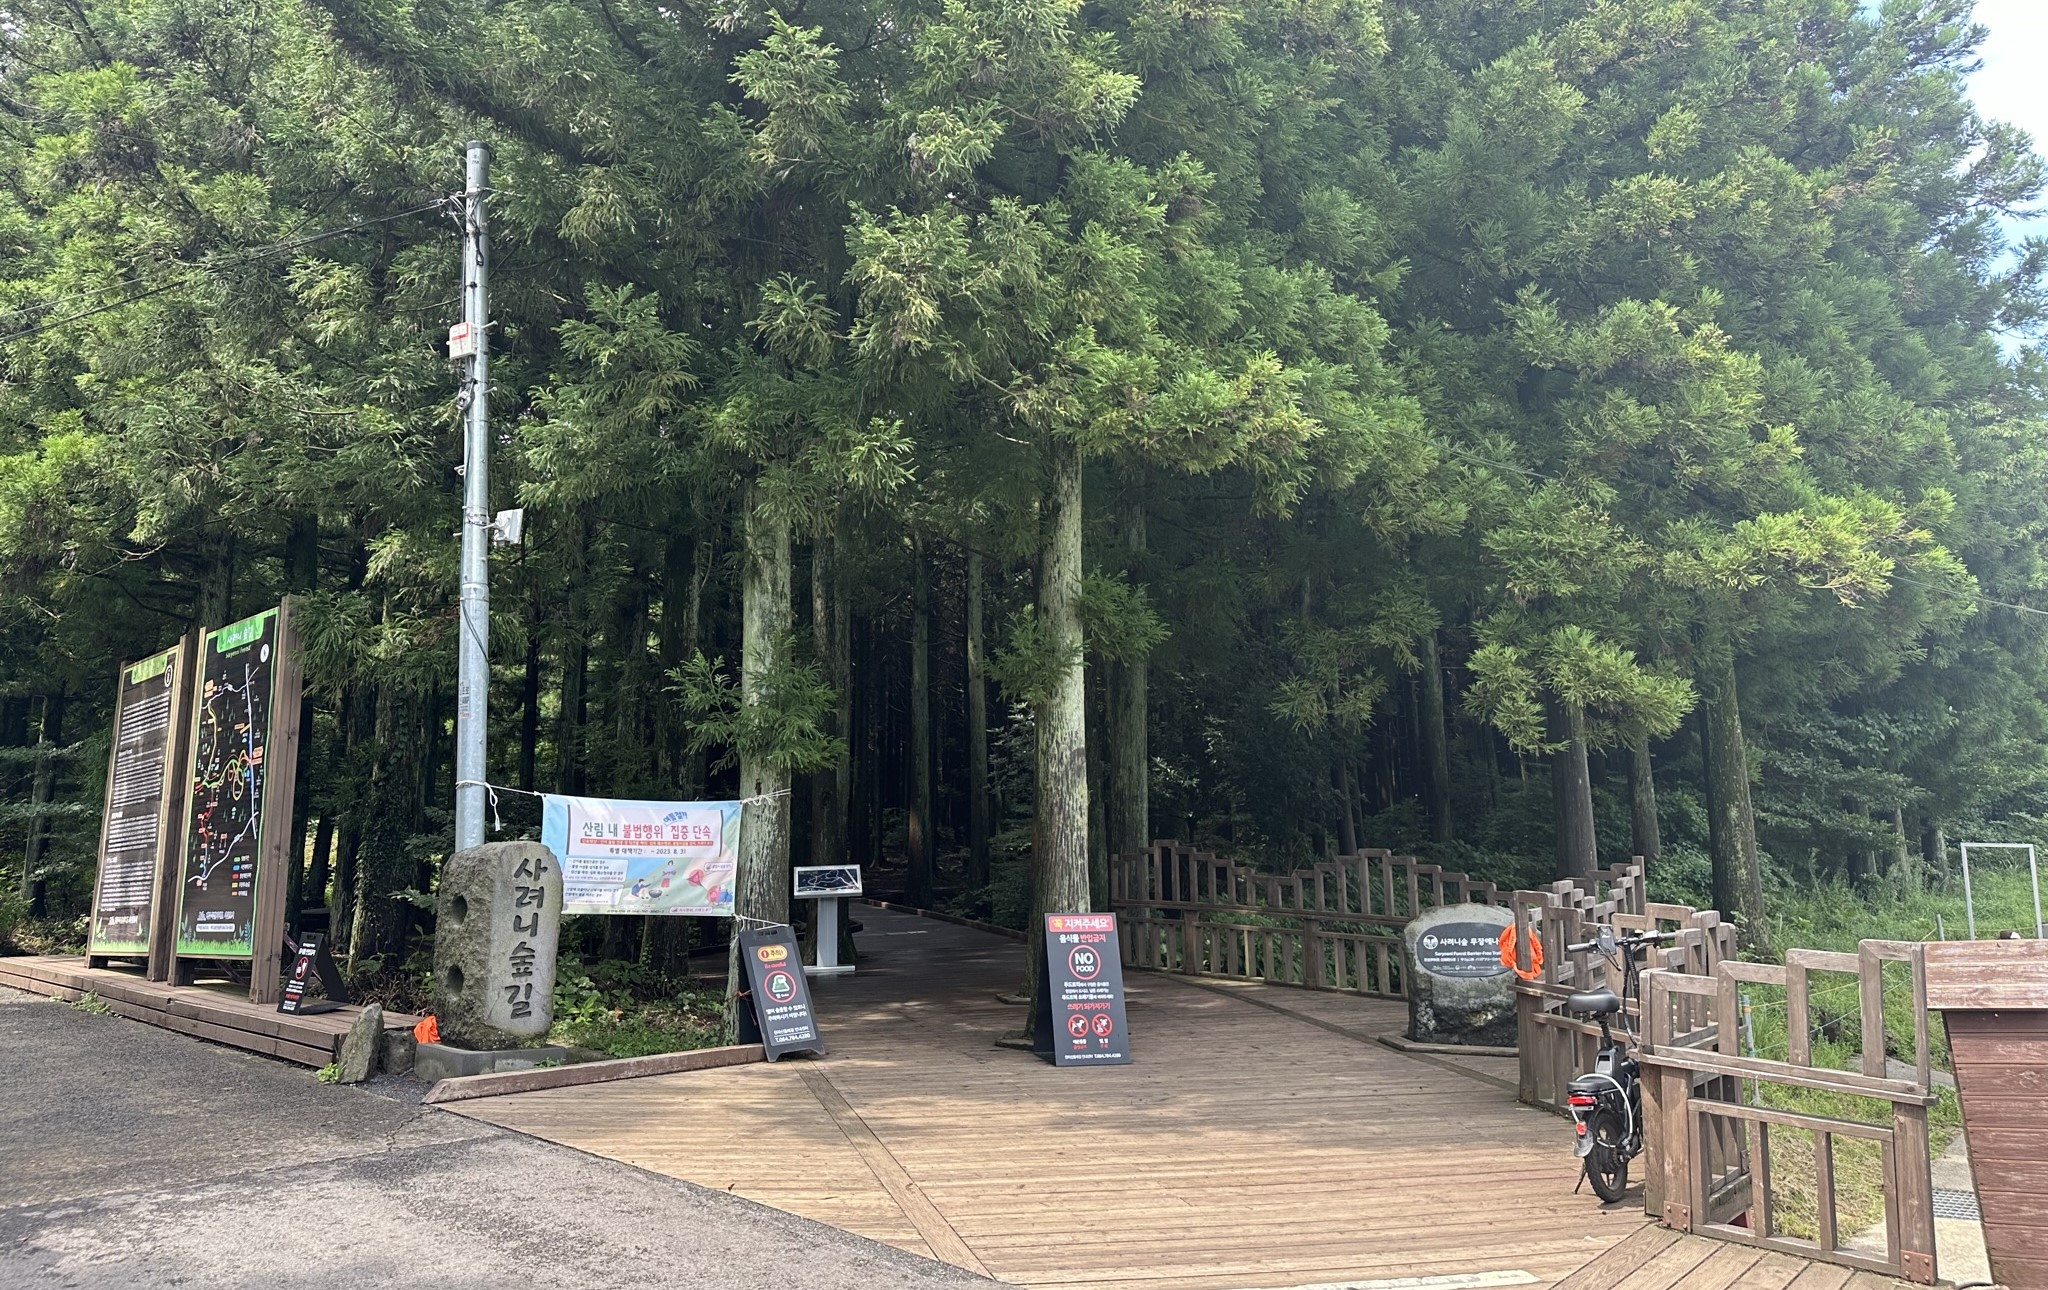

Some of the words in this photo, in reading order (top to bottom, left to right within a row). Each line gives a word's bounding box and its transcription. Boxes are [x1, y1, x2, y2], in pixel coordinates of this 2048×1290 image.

[582, 822, 604, 838] 산림
[608, 823, 618, 838] 내
[622, 824, 663, 839] 불법행위
[670, 825, 689, 840] 집중
[693, 825, 711, 840] 단속
[504, 858, 548, 1020] 사려니숲길
[1059, 934, 1079, 943] 음식물
[1080, 934, 1106, 943] 반입금지
[1440, 938, 1468, 946] 사려니숲
[1074, 953, 1094, 964] NO
